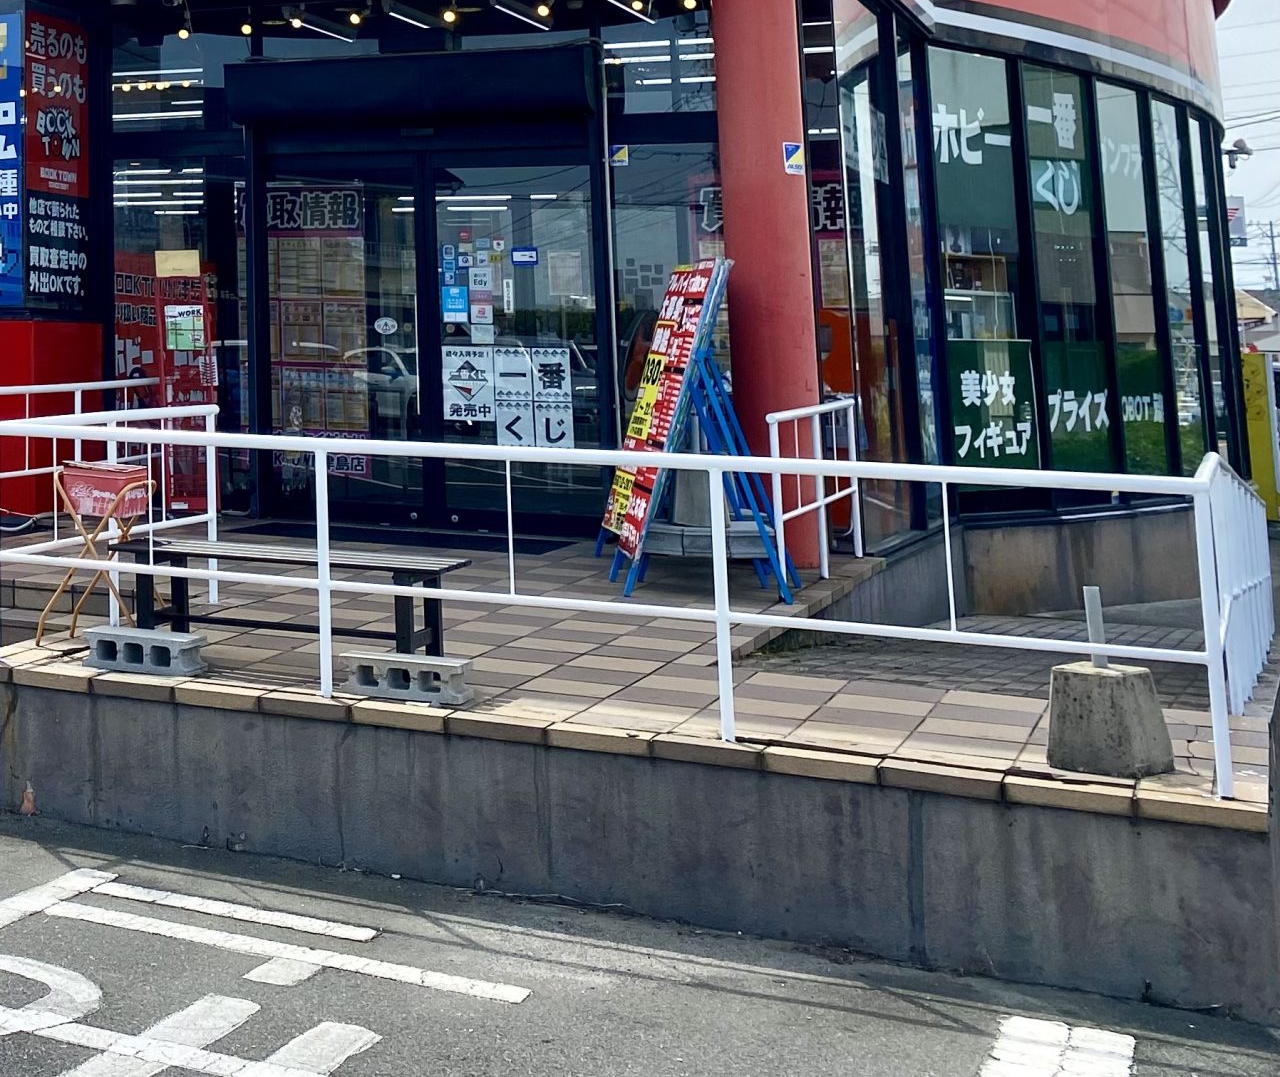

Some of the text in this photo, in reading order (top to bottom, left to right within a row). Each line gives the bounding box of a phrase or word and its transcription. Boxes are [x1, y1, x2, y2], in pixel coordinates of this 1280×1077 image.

[30, 22, 87, 64] 売るのも
[31, 62, 86, 104] 買うのも
[931, 103, 1011, 165] ホビー
[1026, 92, 1076, 150] 一番
[1035, 160, 1080, 215] くじ
[239, 190, 361, 230] 取情報
[29, 245, 88, 271] 買取査定中の
[473, 278, 488, 287] Edy
[960, 369, 1016, 407] 美少女
[449, 403, 491, 418] 発売中
[1047, 388, 1110, 433] プライズ
[954, 420, 1032, 459] フィギュア
